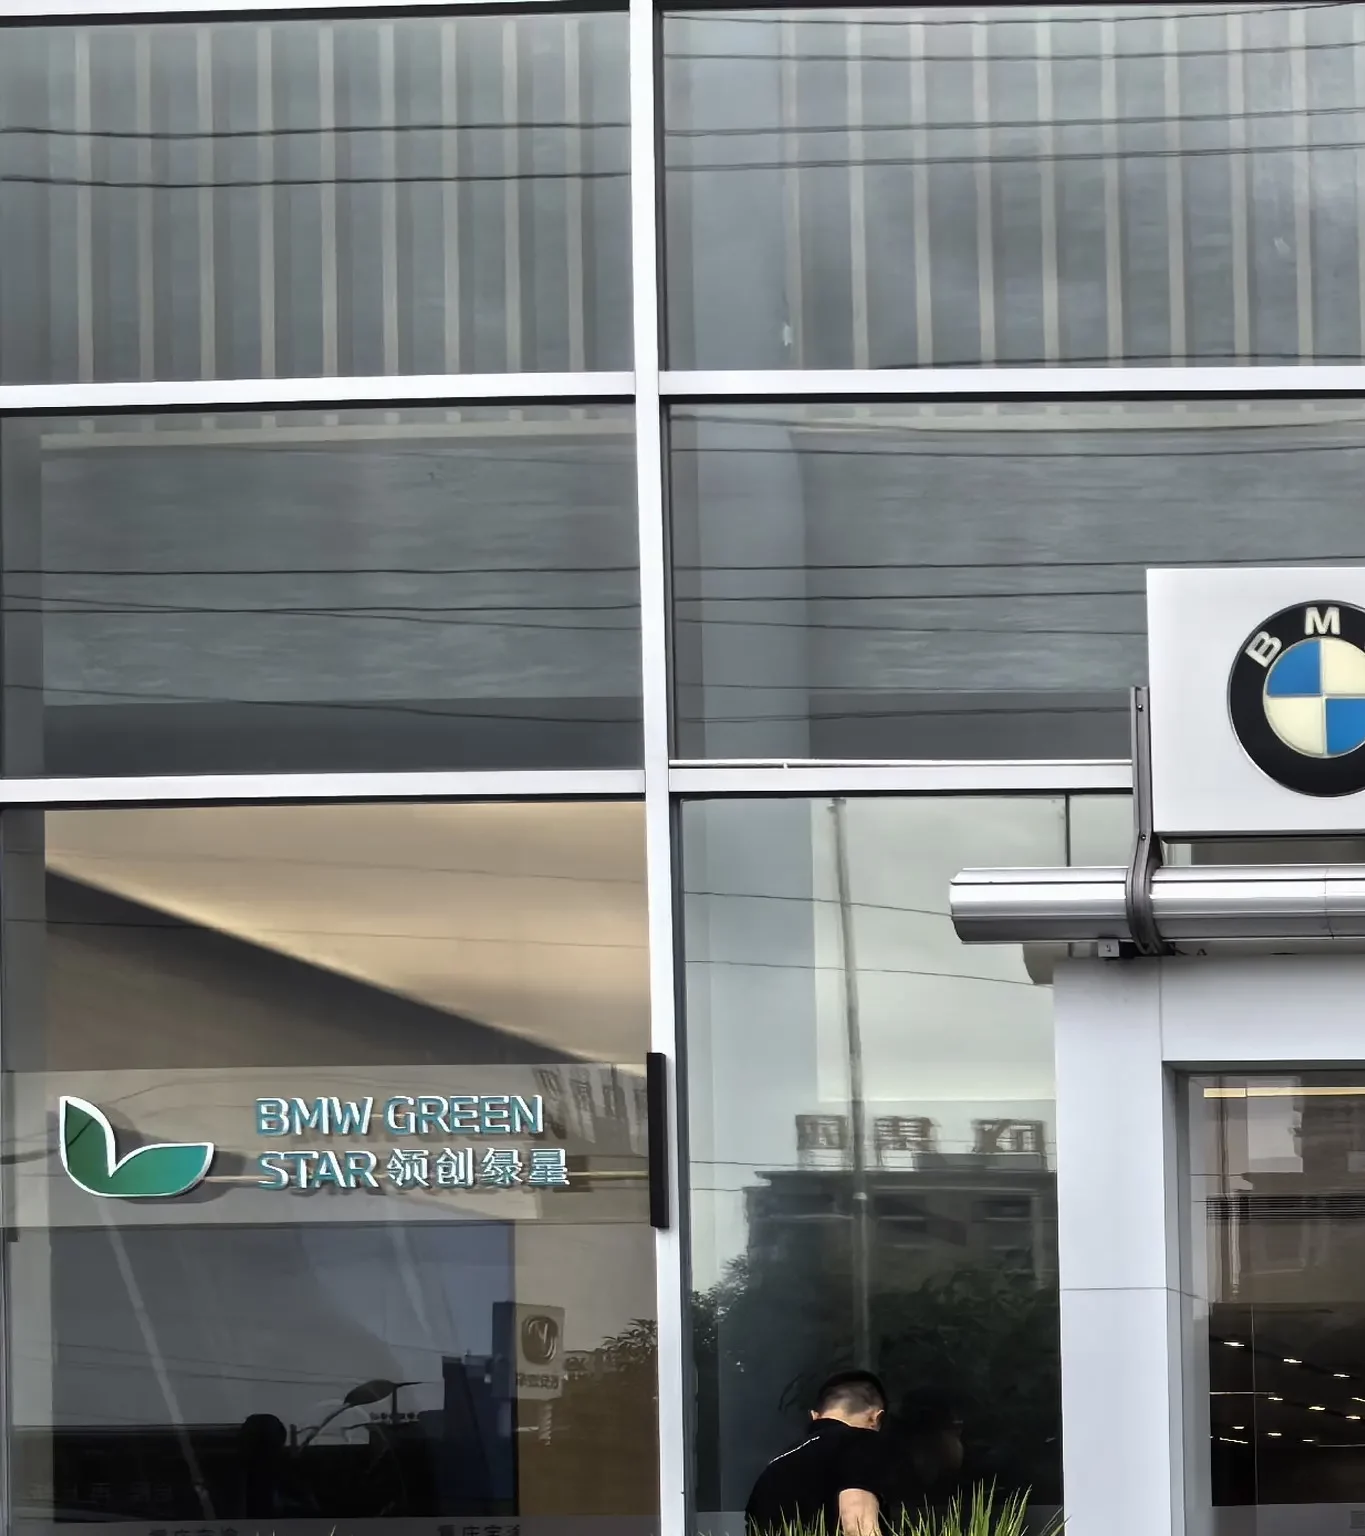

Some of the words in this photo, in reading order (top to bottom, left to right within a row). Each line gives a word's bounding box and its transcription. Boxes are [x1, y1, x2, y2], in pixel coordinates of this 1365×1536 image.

[256, 1096, 374, 1136] BMW
[383, 1095, 543, 1135] GREEN
[258, 1150, 380, 1190] STAR
[386, 1148, 571, 1187] 领创绿星
